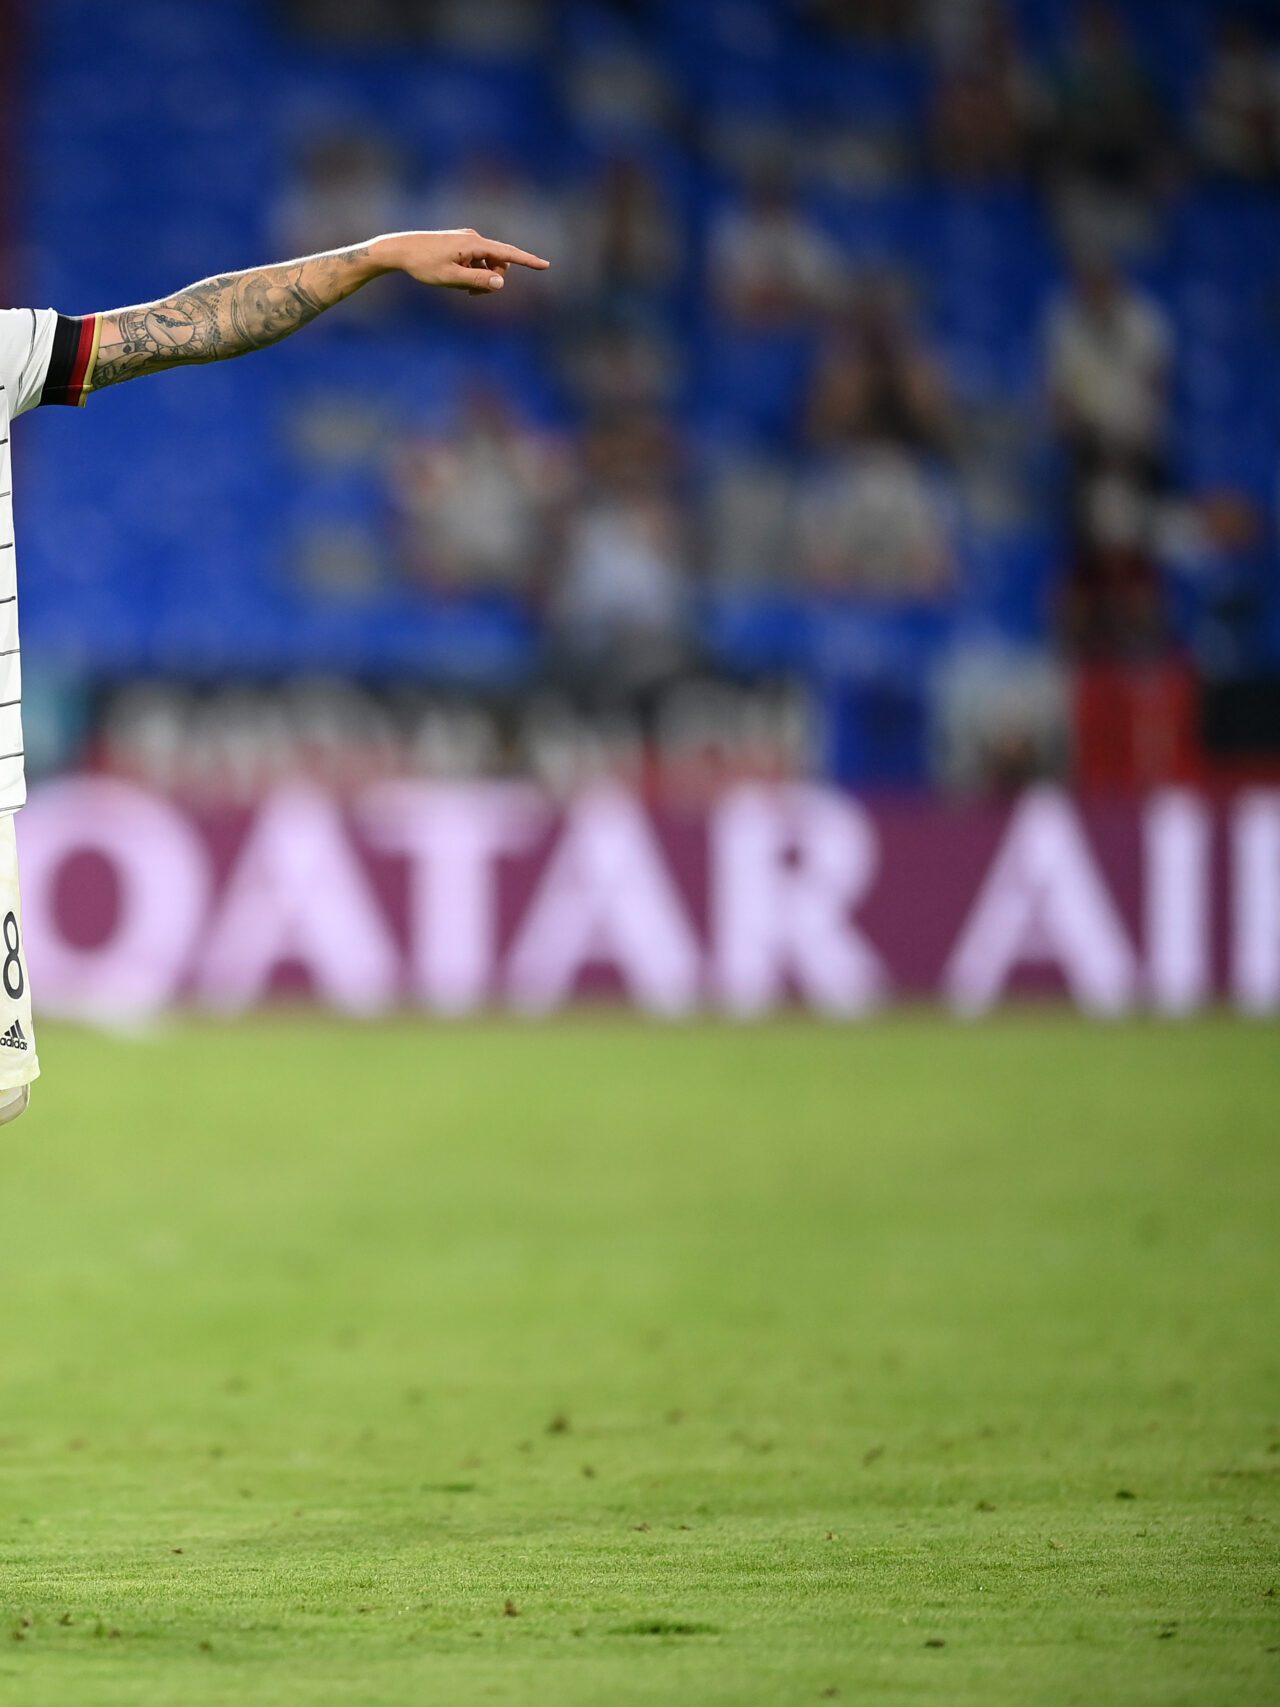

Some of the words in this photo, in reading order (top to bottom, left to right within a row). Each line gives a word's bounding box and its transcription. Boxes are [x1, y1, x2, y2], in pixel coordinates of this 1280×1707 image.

[19, 776, 886, 1030] QATAR
[946, 782, 1280, 1019] AI
[3, 911, 24, 1000] 8
[0, 1037, 27, 1051] adidas
